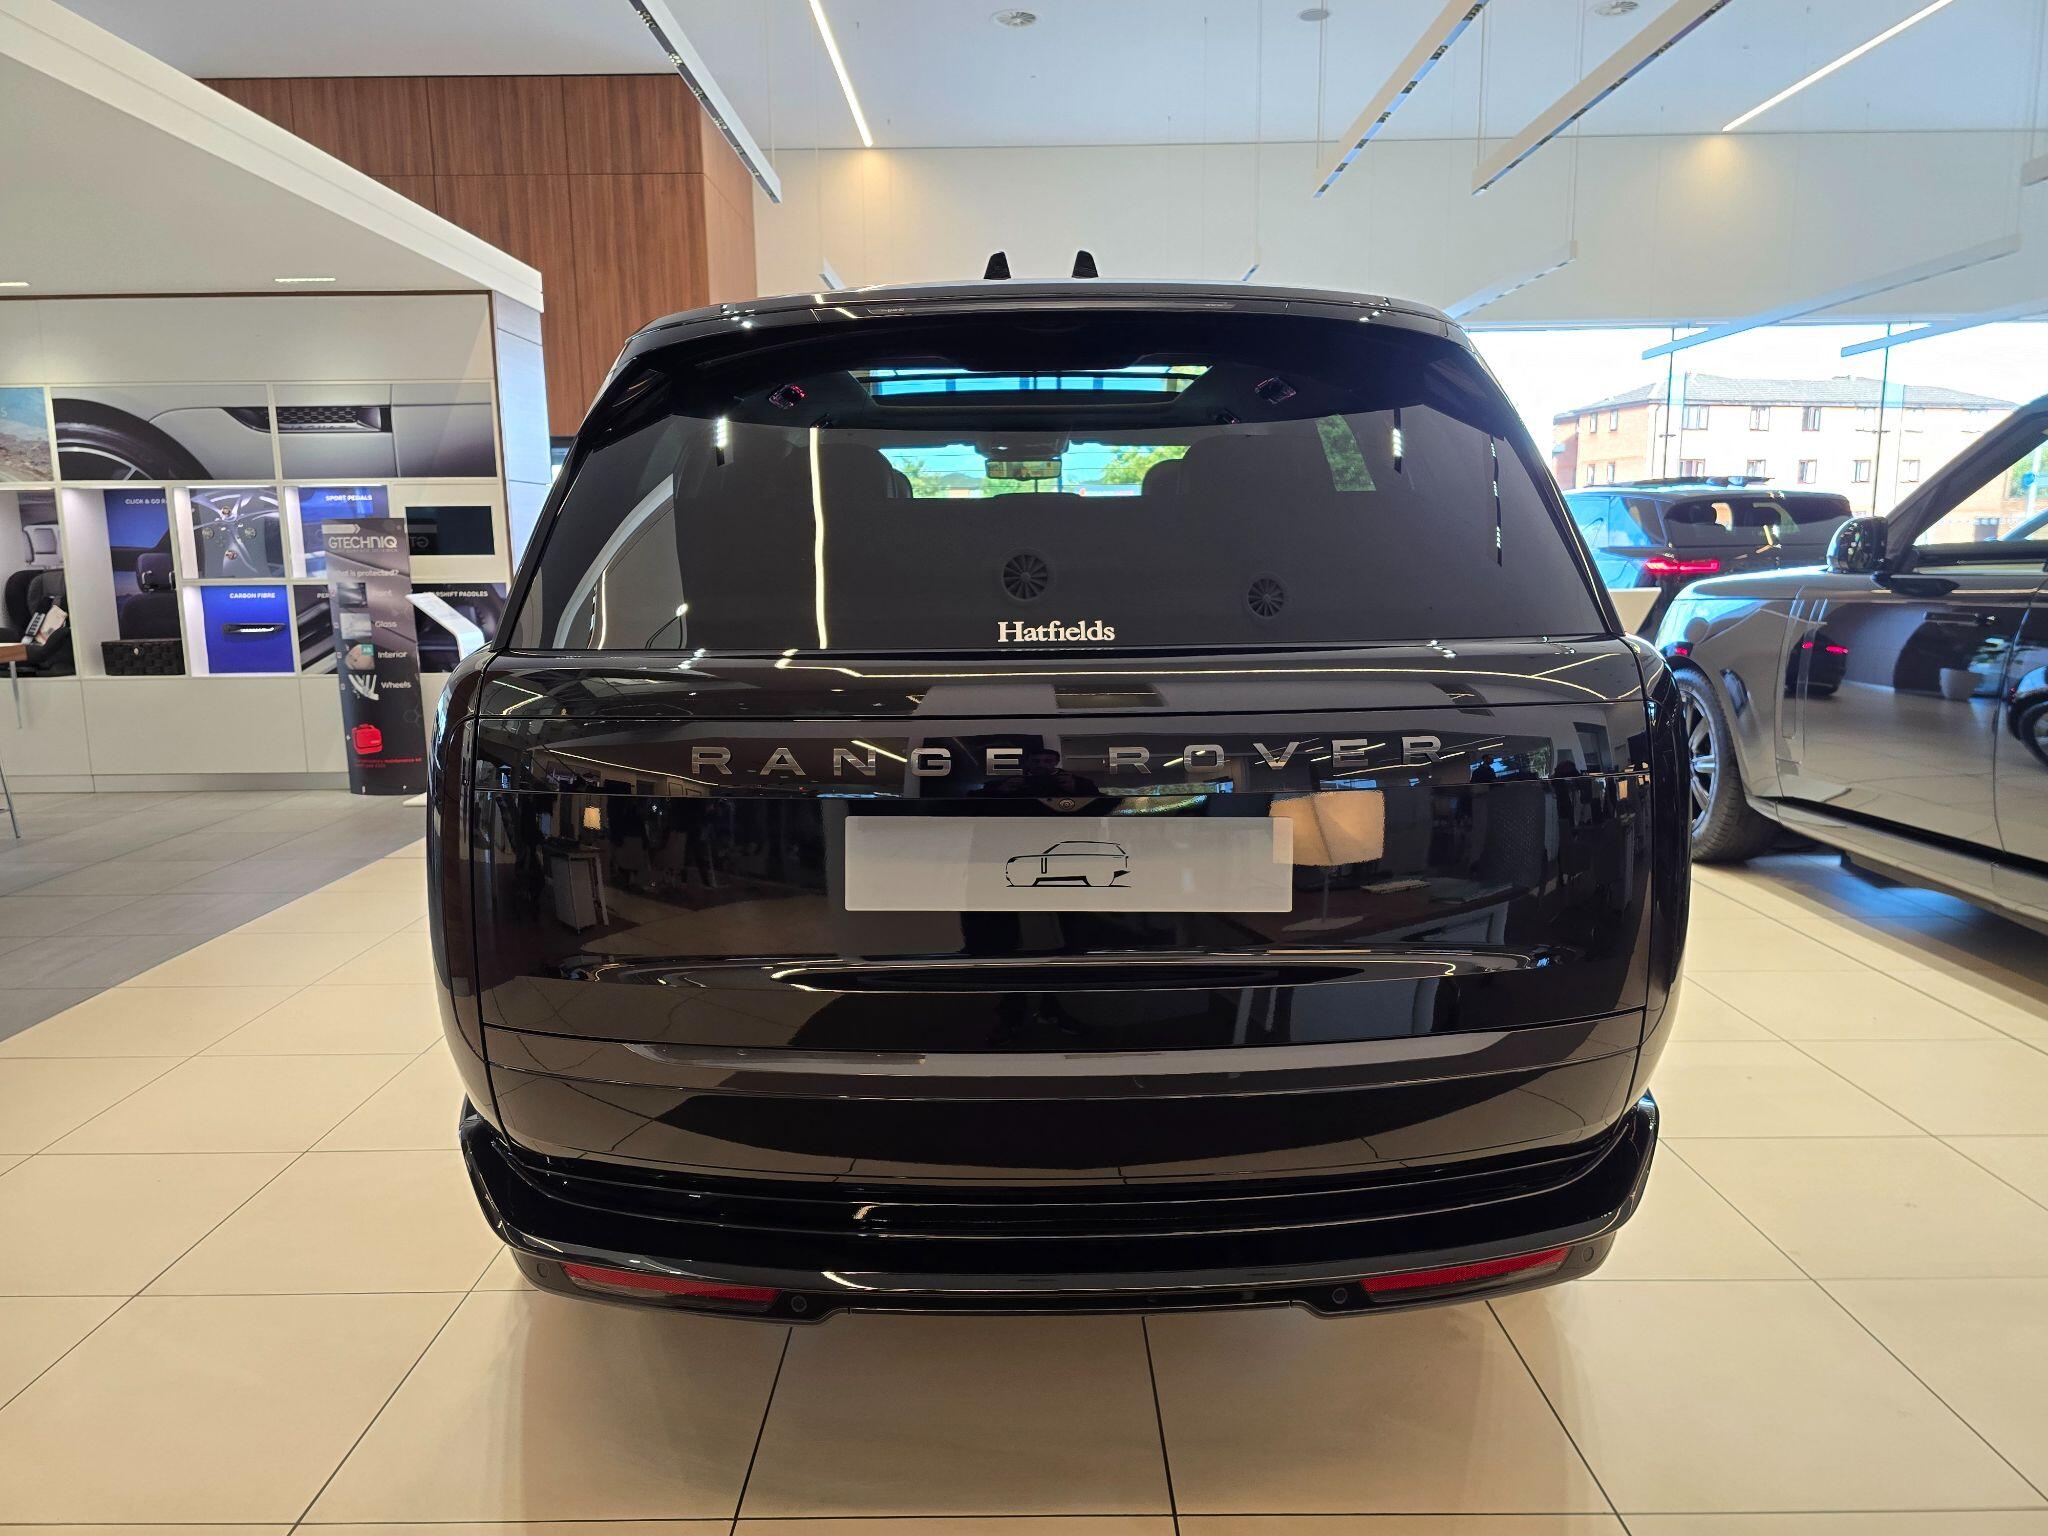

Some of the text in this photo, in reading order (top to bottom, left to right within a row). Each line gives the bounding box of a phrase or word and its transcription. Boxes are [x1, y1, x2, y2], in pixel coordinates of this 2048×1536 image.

[374, 620, 398, 628] Glass
[997, 620, 1116, 643] Hatfields
[377, 651, 408, 659] Interior
[380, 681, 412, 689] Wheels
[691, 735, 1447, 777] RANGE ROVER
